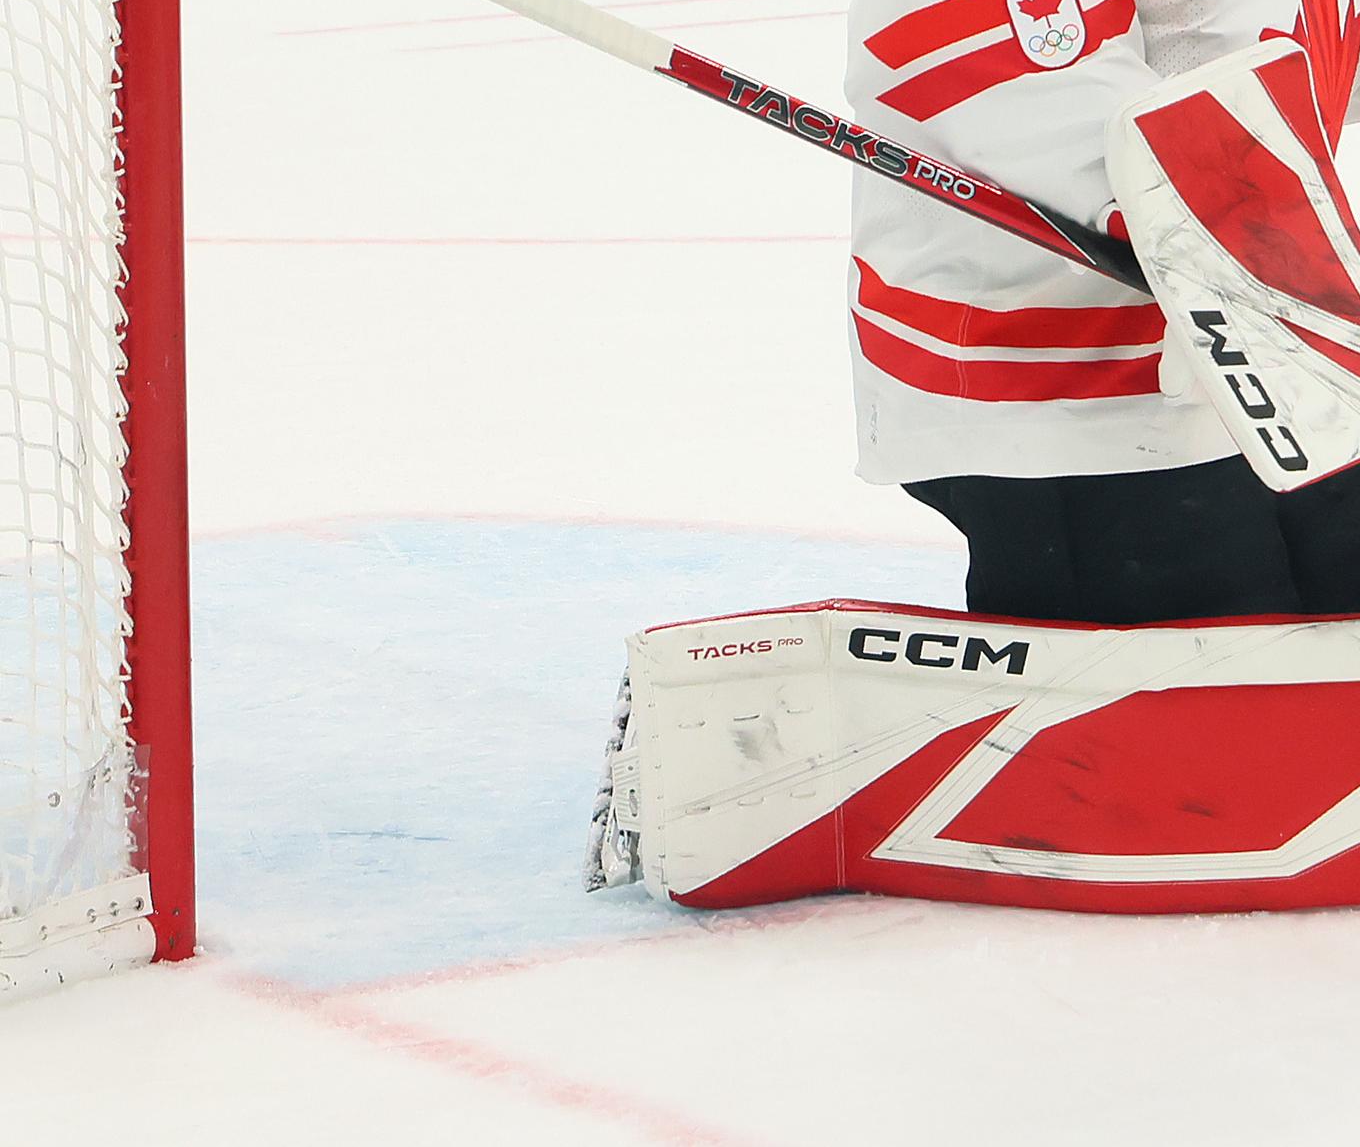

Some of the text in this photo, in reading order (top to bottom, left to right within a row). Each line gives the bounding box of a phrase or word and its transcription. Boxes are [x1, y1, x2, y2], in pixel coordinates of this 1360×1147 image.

[720, 65, 977, 202] TACKS PRO
[1189, 309, 1310, 473] CCM
[687, 635, 805, 662] TACKS PRO
[846, 626, 1031, 676] CCM
